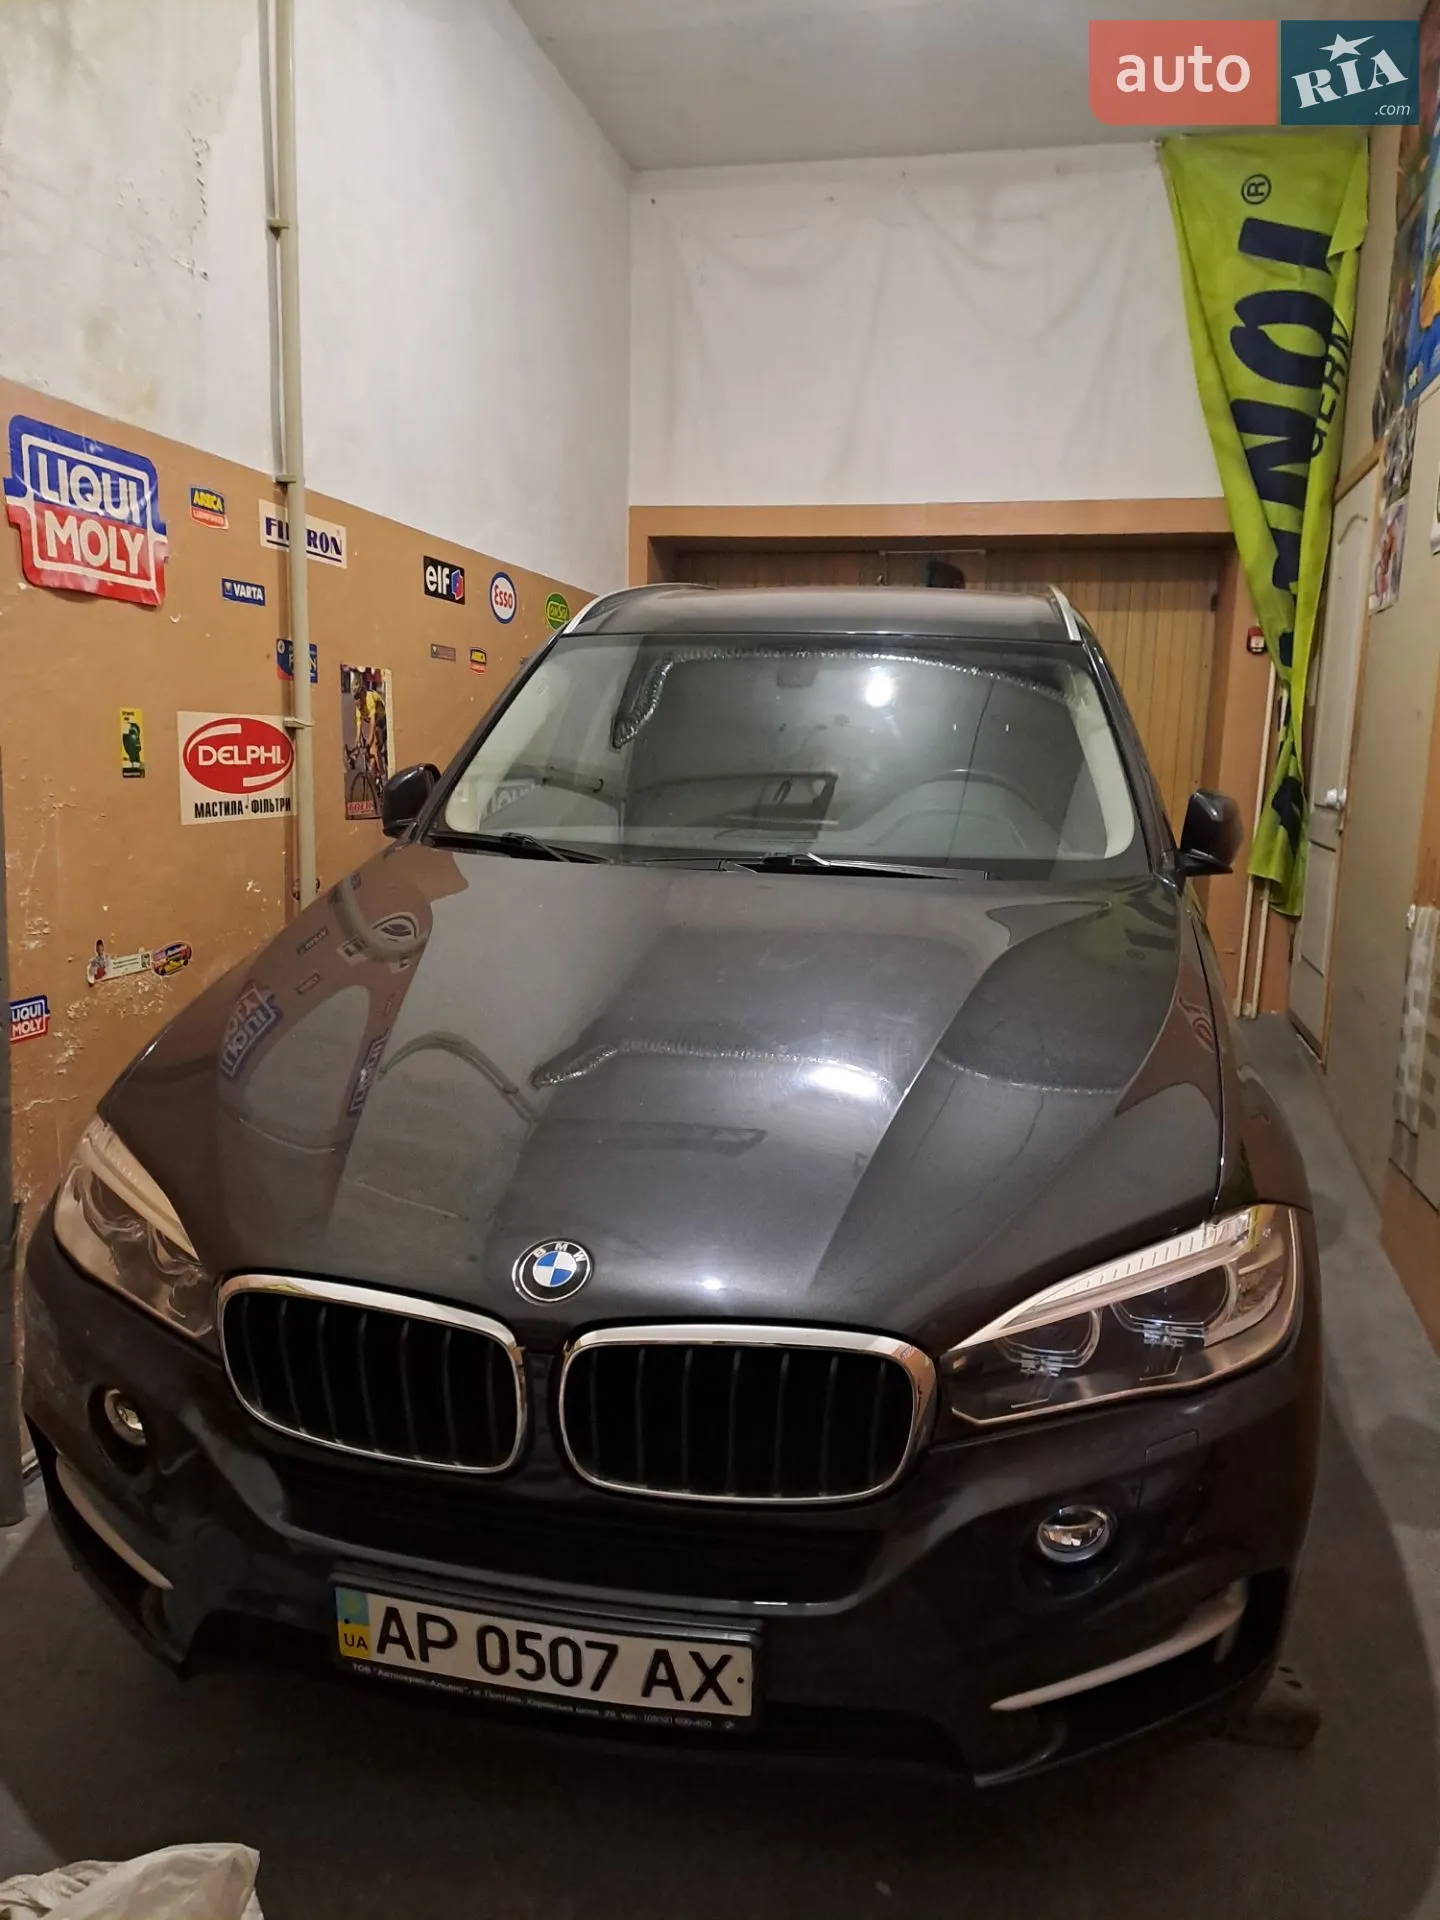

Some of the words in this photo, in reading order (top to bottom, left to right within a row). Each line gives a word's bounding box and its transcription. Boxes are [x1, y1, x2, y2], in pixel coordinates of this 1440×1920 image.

[37, 451, 141, 525] LIQUI
[43, 509, 145, 575] MOLY
[425, 565, 450, 595] elf
[232, 583, 264, 601] VARTA
[197, 745, 281, 766] DELPHI
[194, 800, 244, 819] МАСТИЛА
[251, 797, 291, 814] ФІЛЬТРИ
[11, 1003, 42, 1022] LIQUI
[12, 1018, 42, 1037] MOLY
[532, 1241, 588, 1263] BMW
[343, 1632, 369, 1652] UA
[376, 1605, 459, 1664] AP
[475, 1624, 619, 1693] 0507
[641, 1647, 734, 1707] AX
